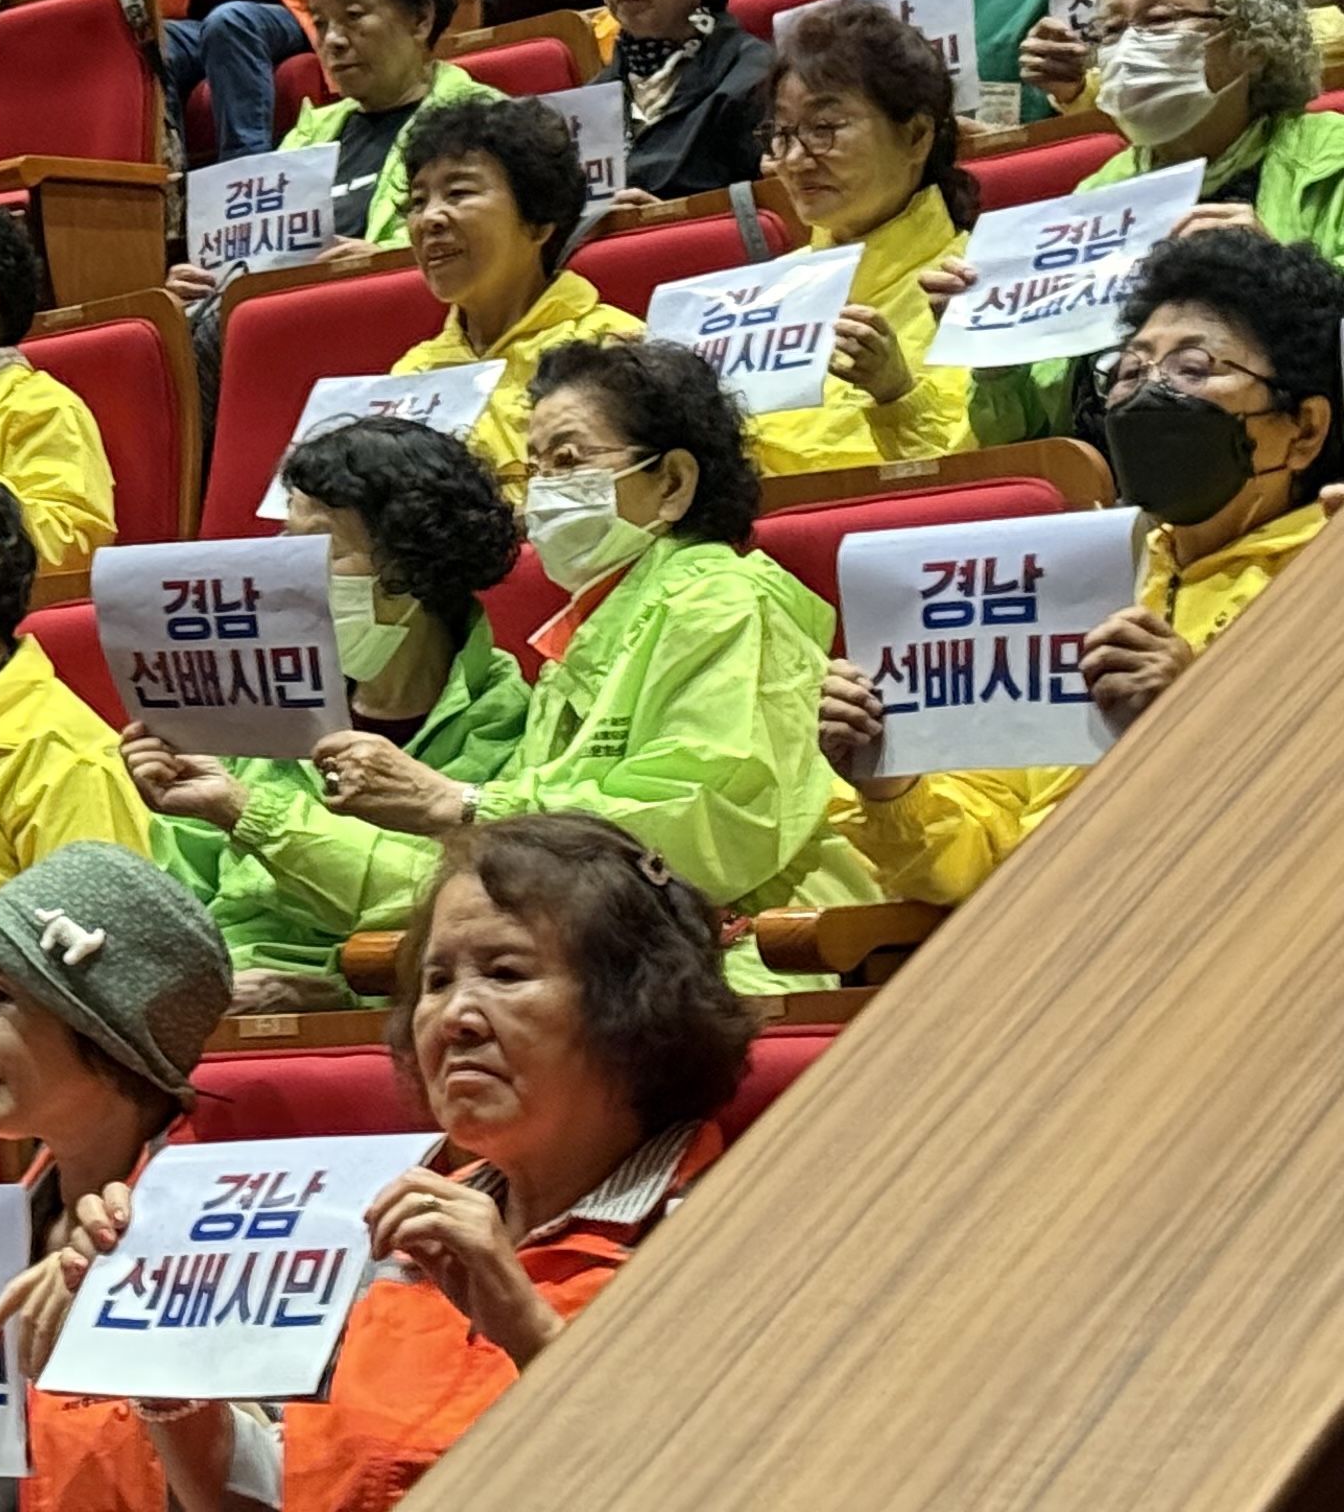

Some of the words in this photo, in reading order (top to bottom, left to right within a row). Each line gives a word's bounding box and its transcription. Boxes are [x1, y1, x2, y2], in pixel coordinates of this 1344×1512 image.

[225, 178, 290, 220] 경남
[199, 209, 320, 269] 선배시민
[1033, 209, 1135, 271] 경남
[693, 322, 822, 375] 배시민
[162, 577, 260, 641] 경남
[920, 554, 1043, 629] 경남
[130, 646, 324, 710] 선배시민
[873, 632, 1093, 714] 선배시민
[189, 1170, 328, 1242] 경남
[94, 1248, 348, 1329] 선배시민
